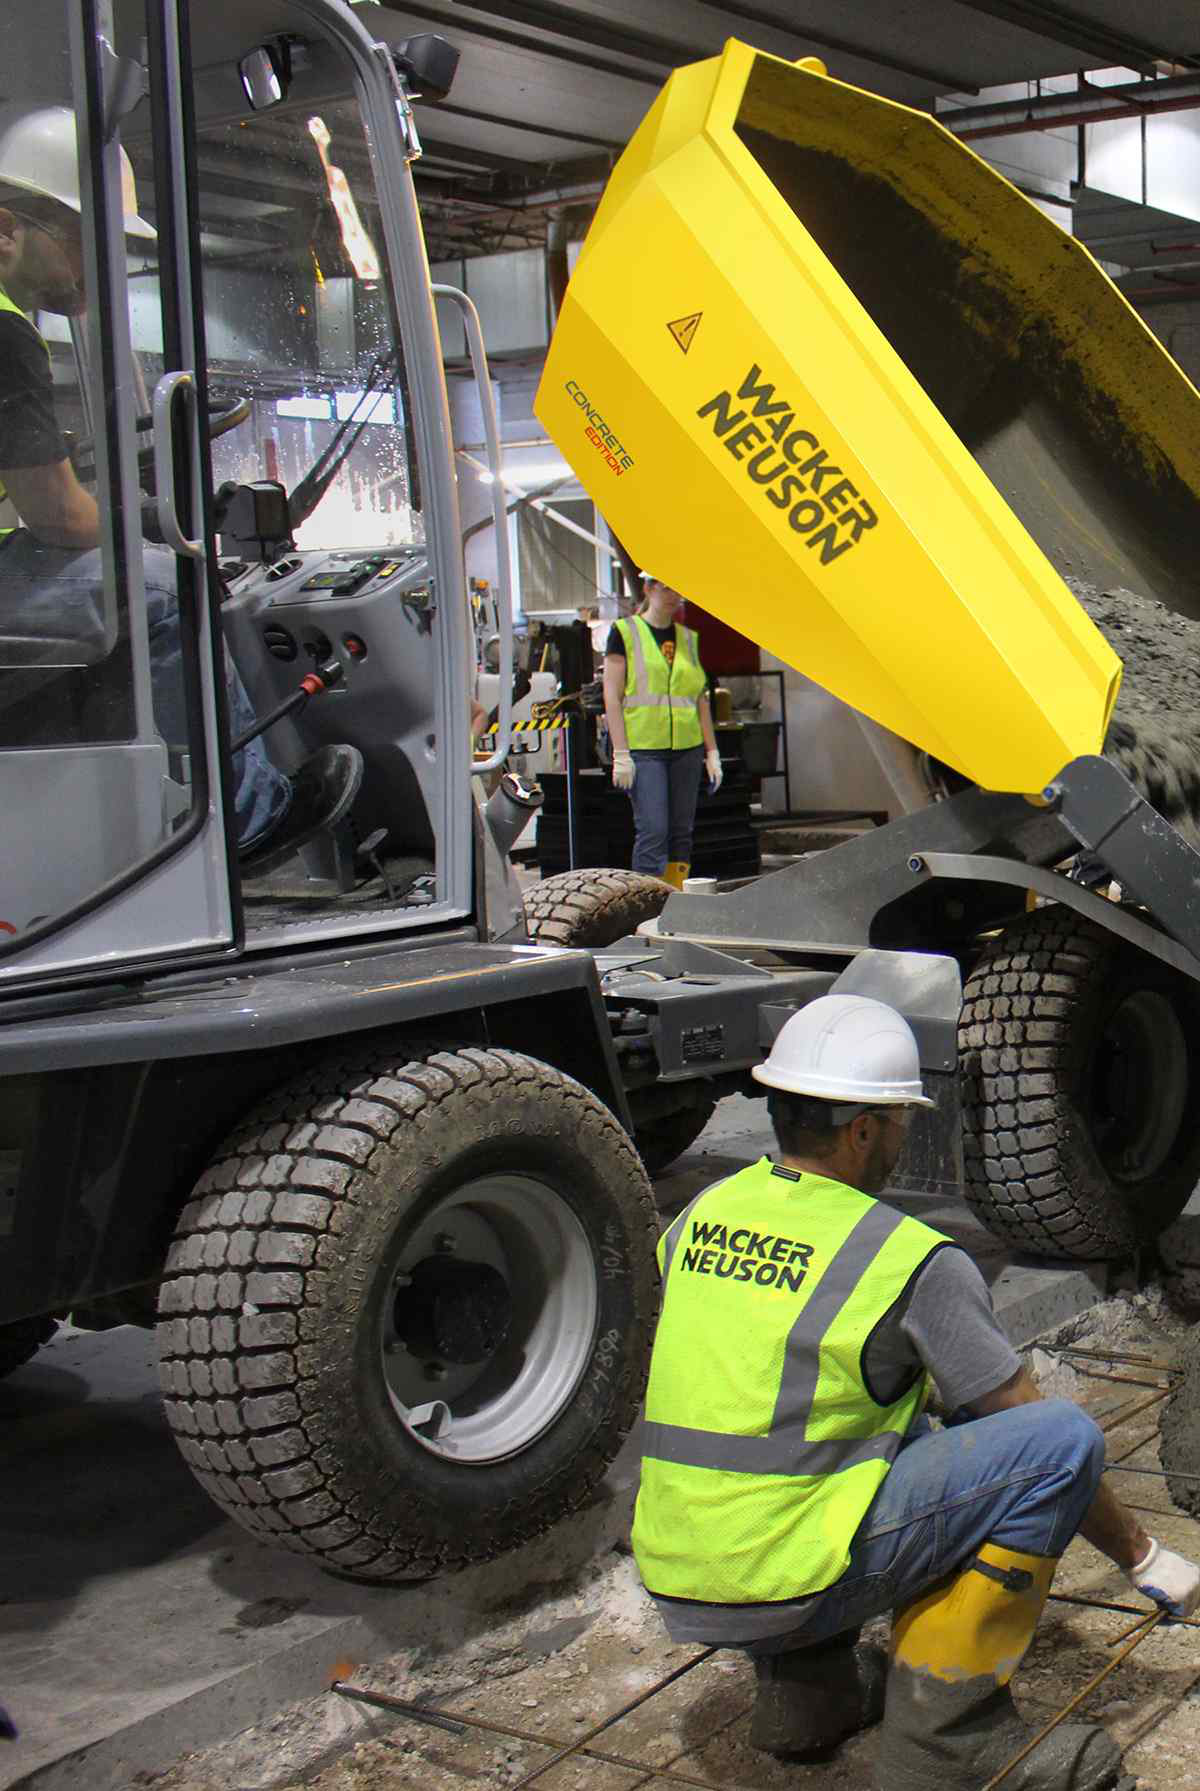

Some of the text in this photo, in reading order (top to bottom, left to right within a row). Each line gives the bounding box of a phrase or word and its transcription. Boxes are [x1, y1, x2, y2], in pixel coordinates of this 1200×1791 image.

[565, 381, 635, 470] CONCRETE
[584, 426, 625, 477] EDITION
[737, 364, 879, 544] WACKER
[696, 391, 854, 566] NEUSON
[680, 1247, 807, 1293] NEUSON
[692, 1221, 815, 1268] WACKER
